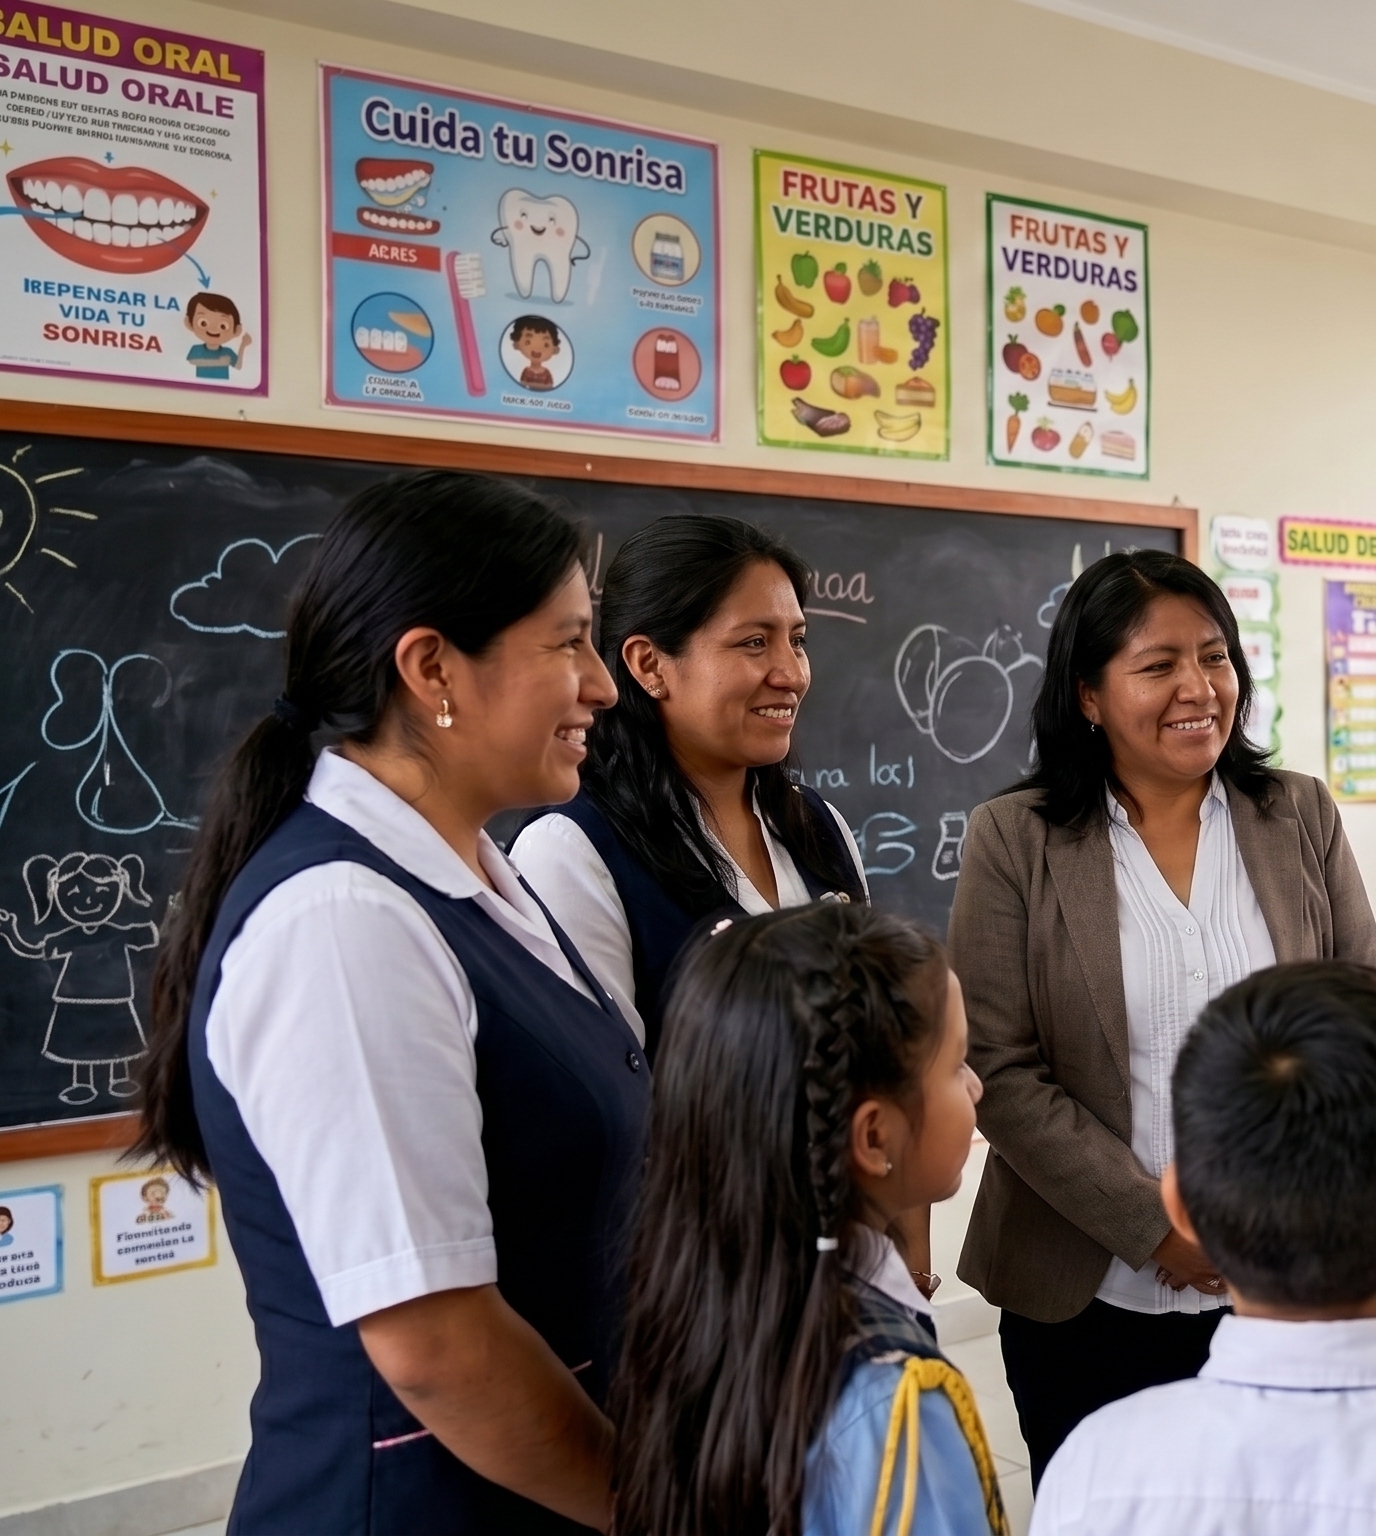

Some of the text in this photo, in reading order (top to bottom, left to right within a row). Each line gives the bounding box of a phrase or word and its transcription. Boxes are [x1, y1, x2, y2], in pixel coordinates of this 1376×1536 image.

[0, 9, 241, 83] ALUD ORAL
[121, 78, 235, 119] ORALE
[364, 100, 684, 190] Cuida tu Sonrisa
[782, 170, 922, 219] FRUTAS Y
[772, 206, 933, 256] VERDURAS
[1010, 214, 1129, 258] FRUTAS Y
[1002, 246, 1138, 292] VERDURAS
[59, 303, 145, 327] VIDA TU
[154, 295, 181, 312] LA
[43, 323, 163, 353] SONRISA
[1287, 529, 1349, 555] SALUD
